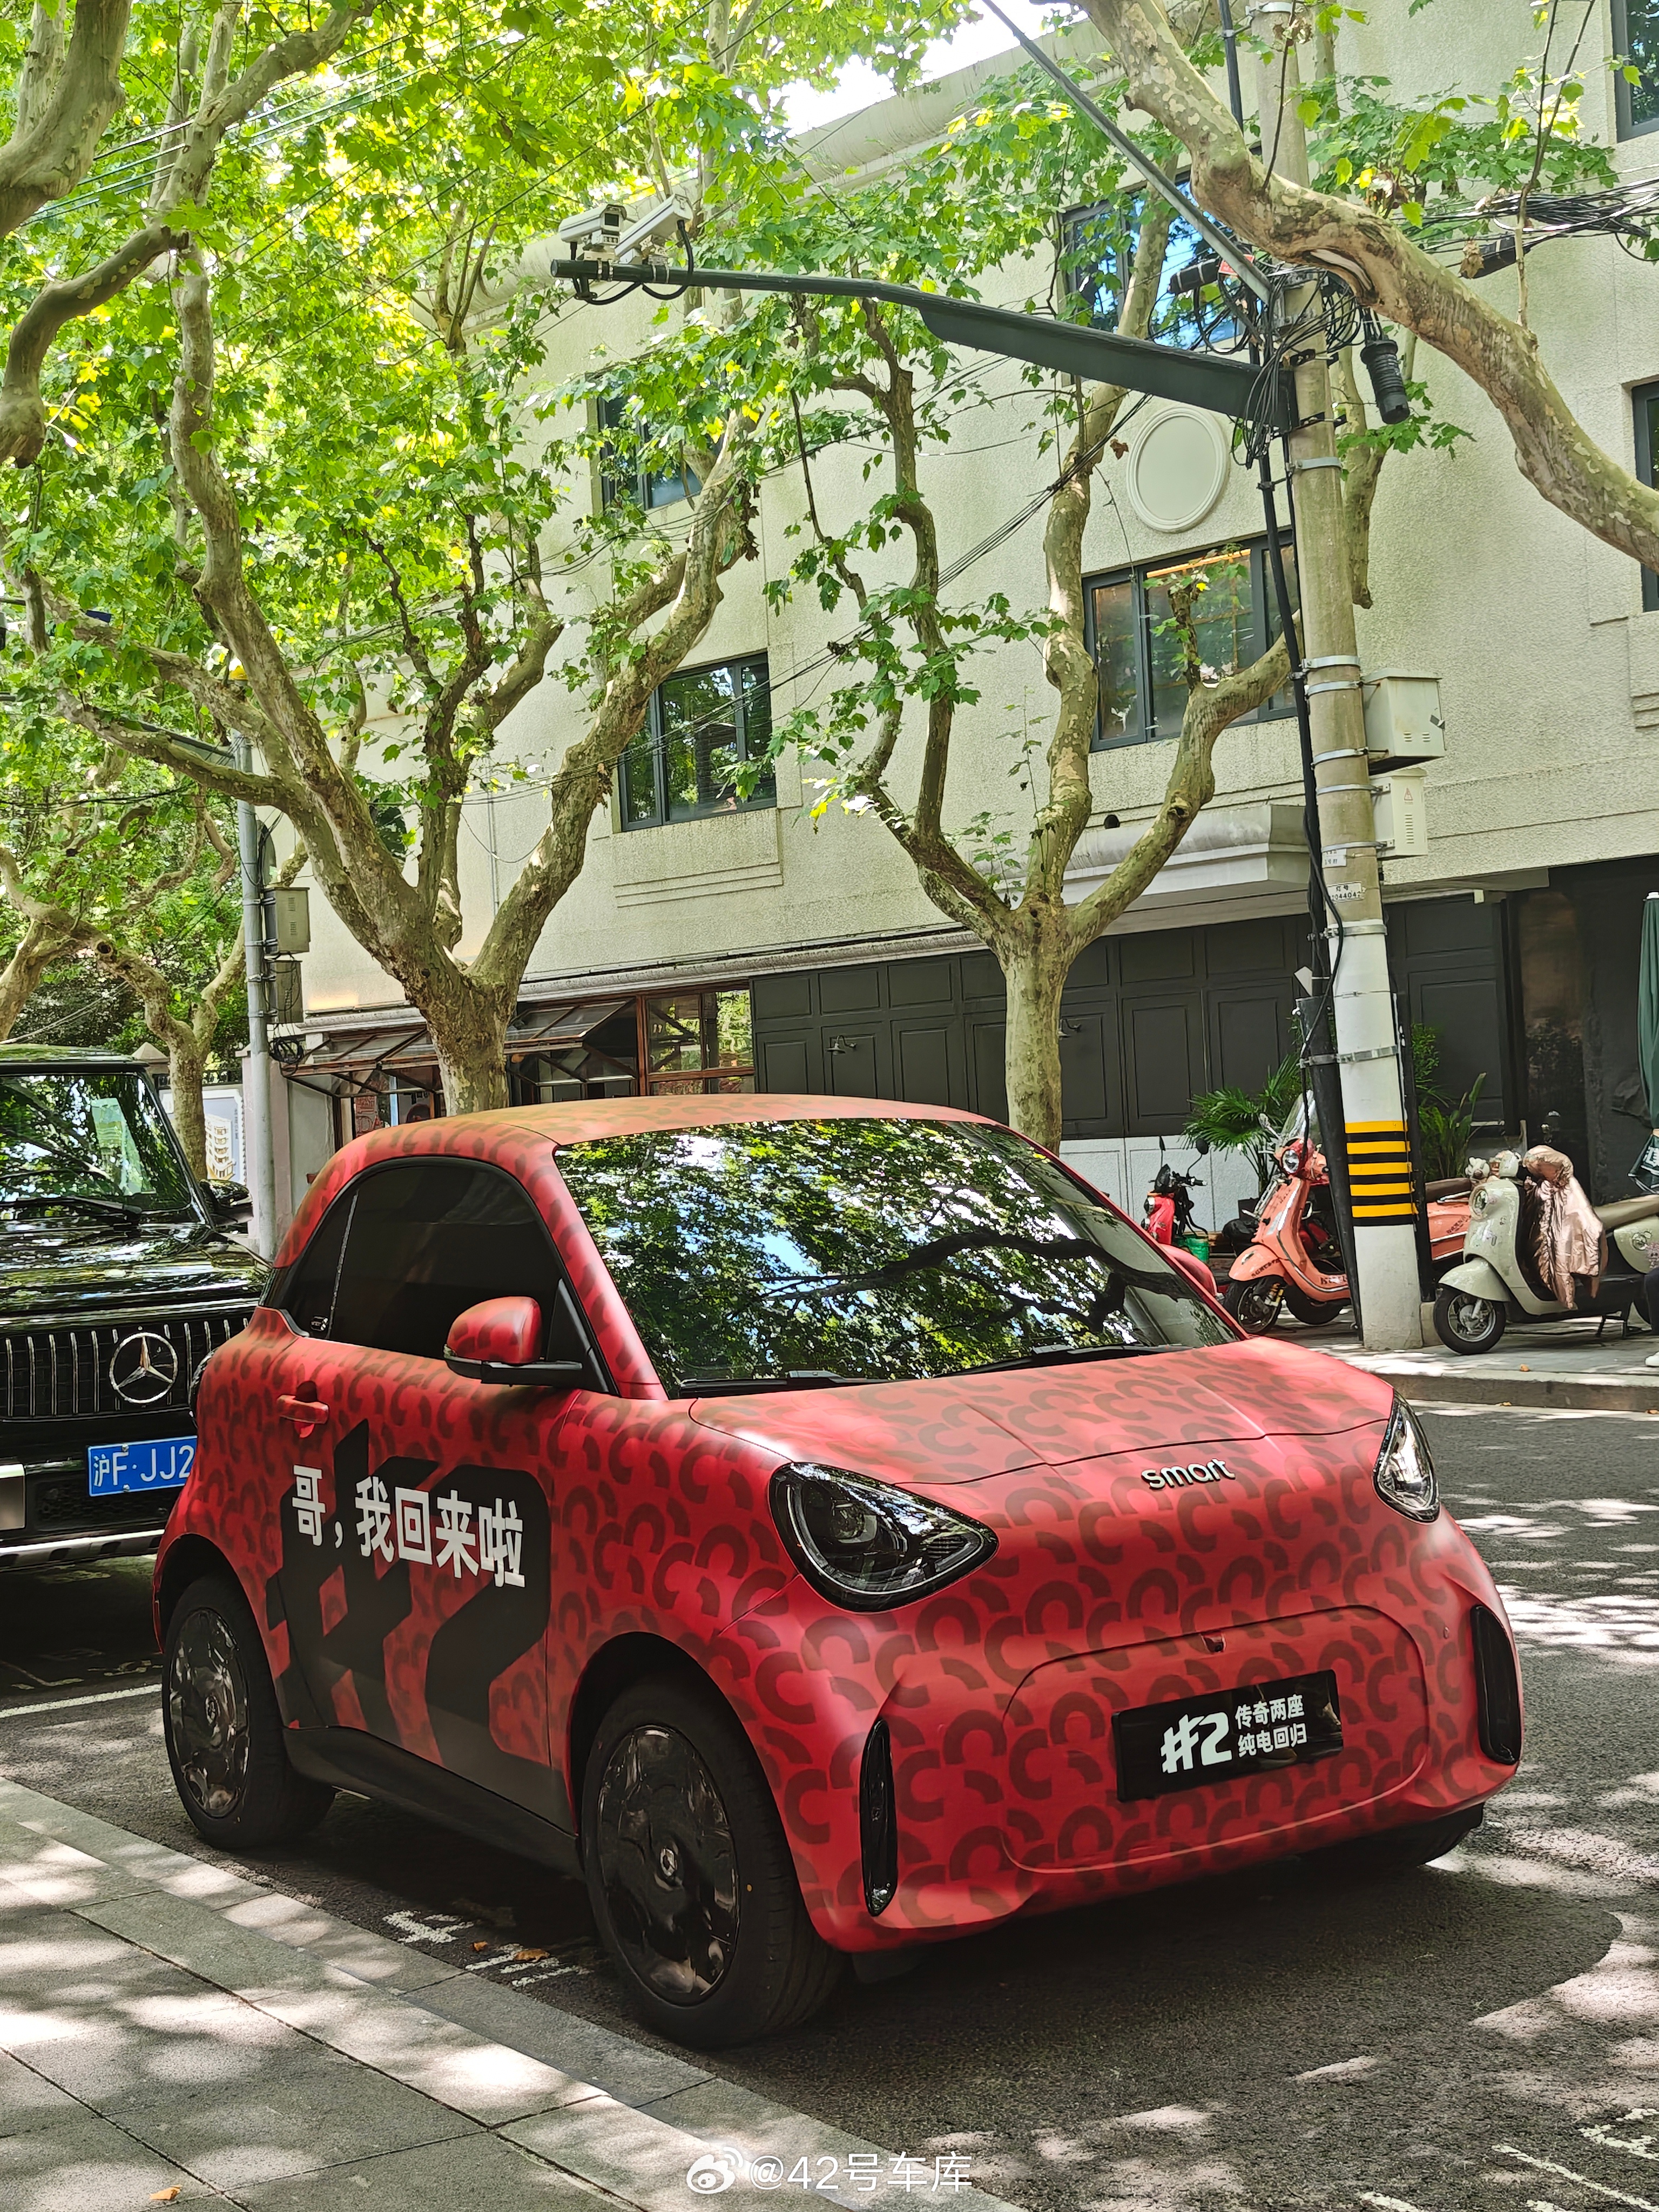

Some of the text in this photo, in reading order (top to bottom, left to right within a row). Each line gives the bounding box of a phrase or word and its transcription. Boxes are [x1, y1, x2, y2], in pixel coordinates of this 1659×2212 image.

[1141, 1458, 1236, 1490] smart
[1235, 1694, 1305, 1729] 传奇两座
[1161, 1712, 1232, 1774] #2
[1237, 1723, 1307, 1758] 纯电回归
